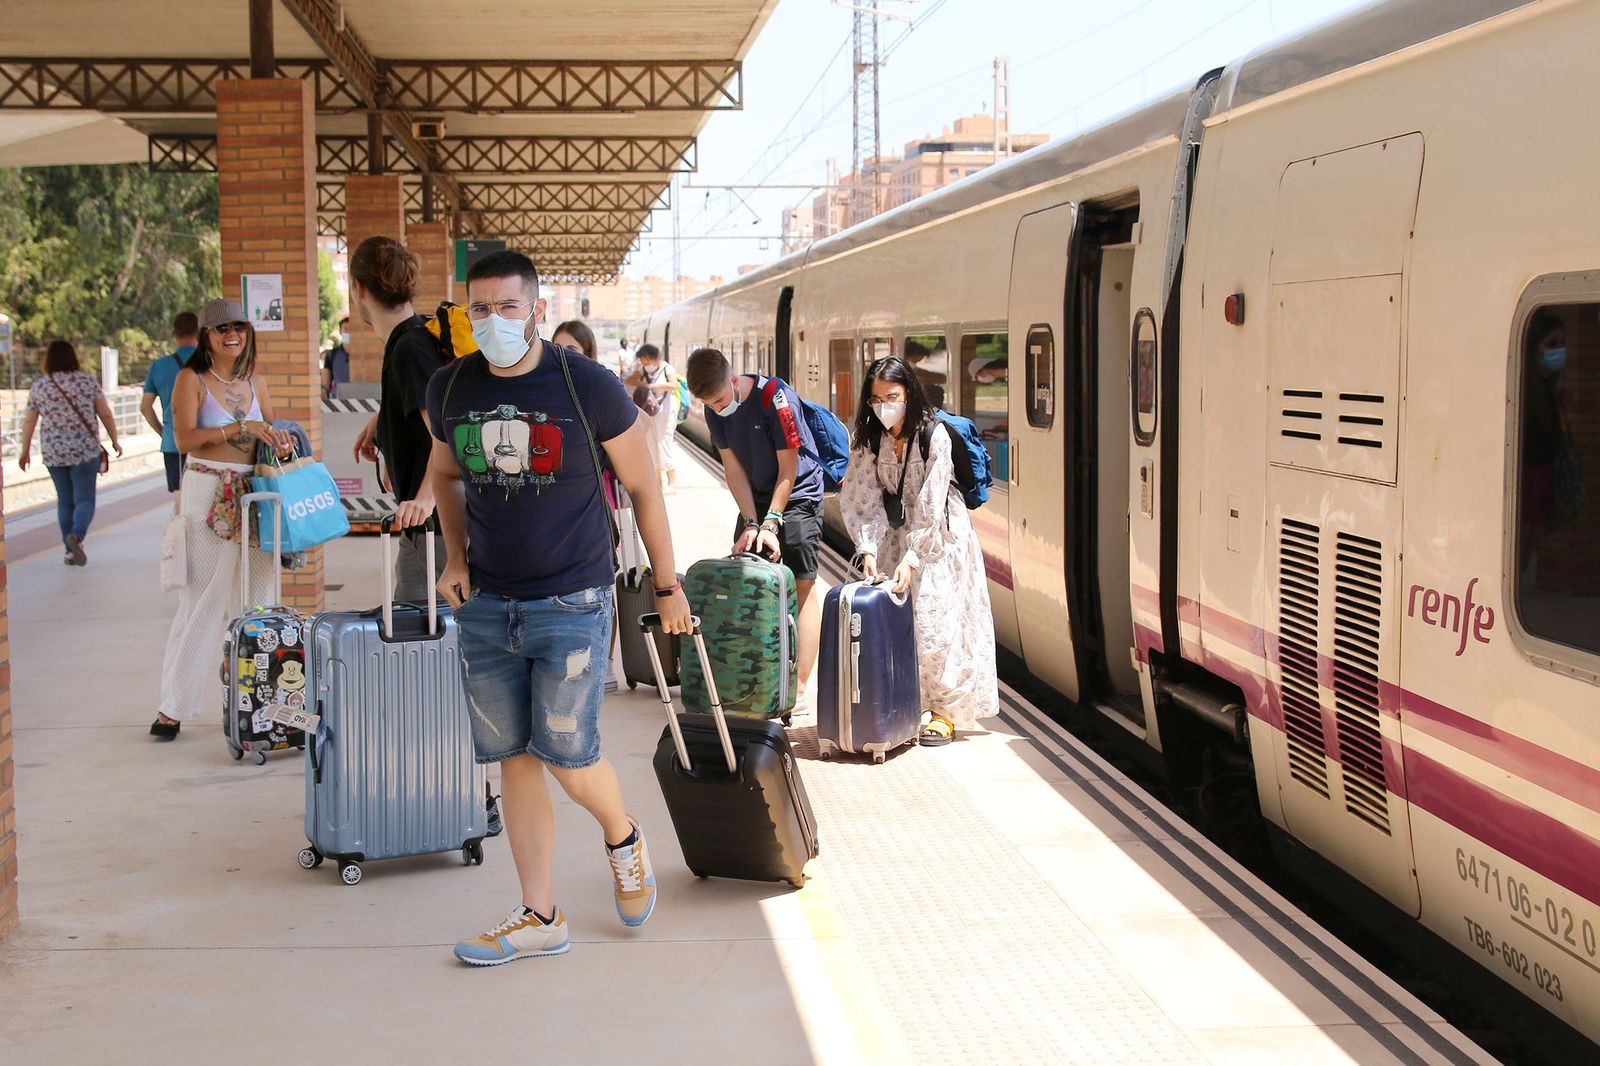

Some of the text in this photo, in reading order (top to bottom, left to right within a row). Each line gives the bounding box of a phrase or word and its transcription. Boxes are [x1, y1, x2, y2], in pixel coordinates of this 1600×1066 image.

[287, 490, 335, 520] casas
[1407, 577, 1495, 656] renfe
[1463, 915, 1564, 1002] TB6-602 023
